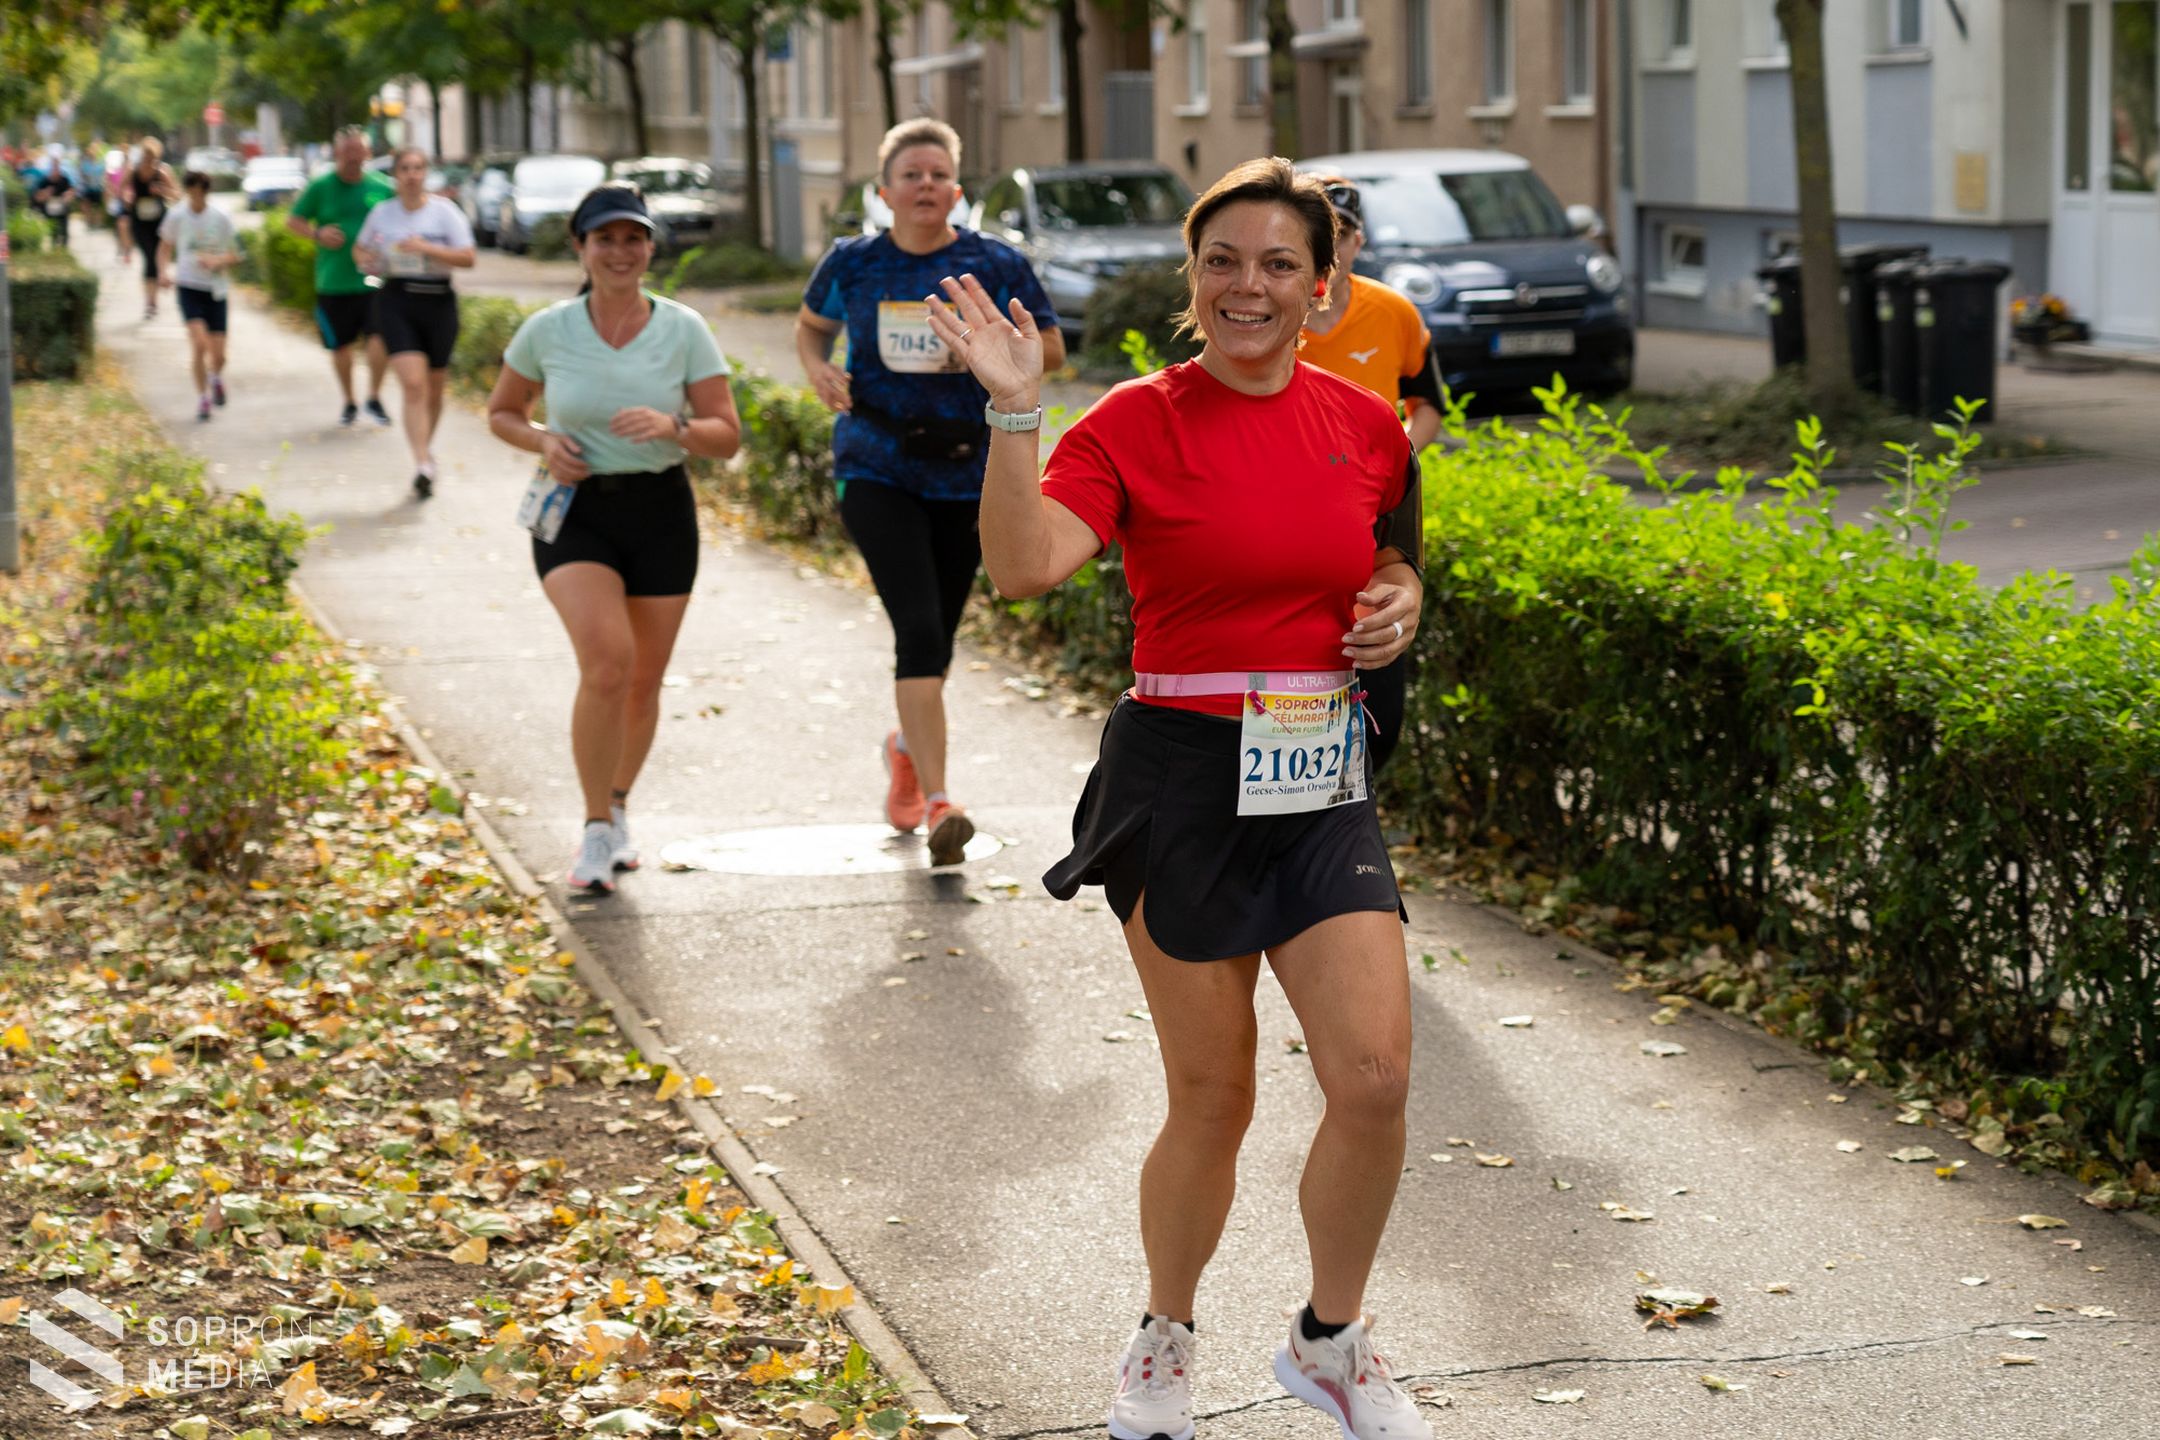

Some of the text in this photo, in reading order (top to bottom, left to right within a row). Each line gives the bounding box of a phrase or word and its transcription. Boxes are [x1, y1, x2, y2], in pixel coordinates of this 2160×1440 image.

[888, 333, 940, 353] 7045
[1274, 698, 1327, 711] SOPRON
[1244, 743, 1341, 782] 21032
[1246, 784, 1305, 796] Gecse-Simon
